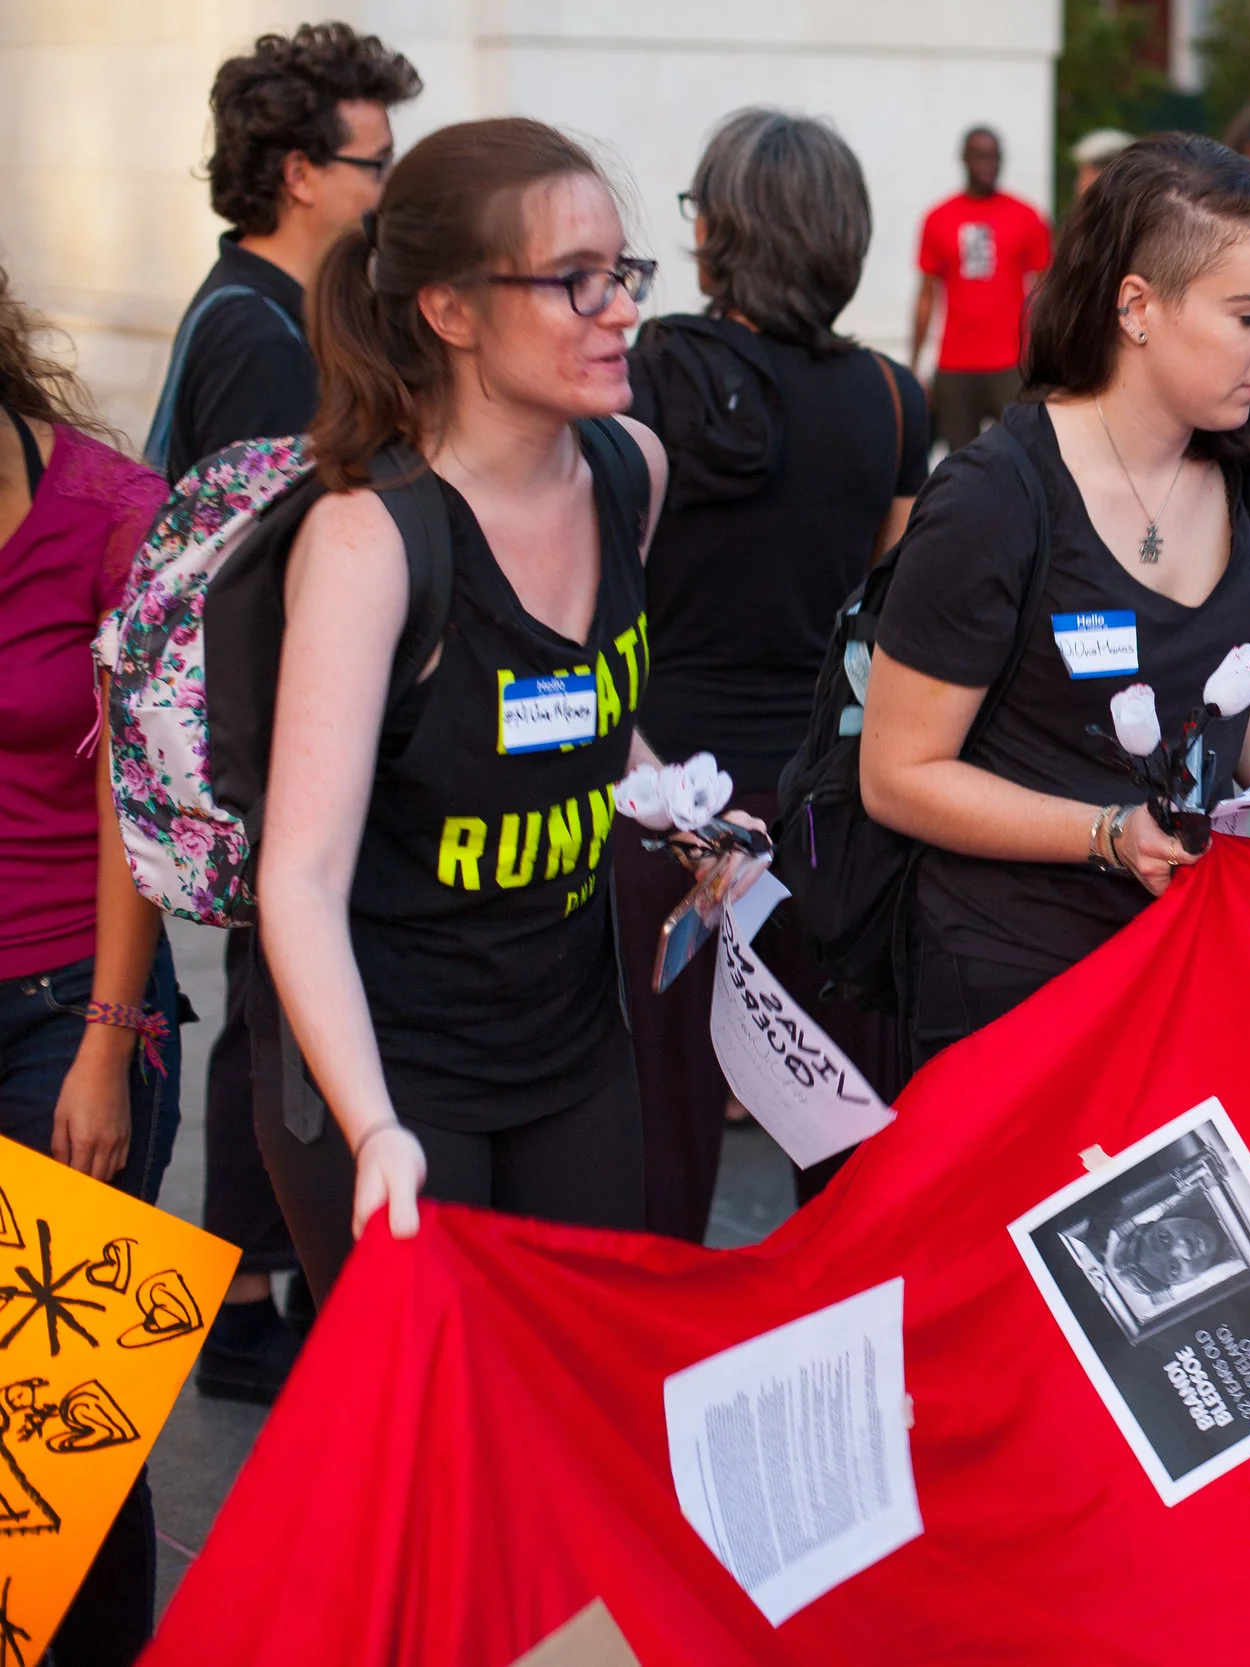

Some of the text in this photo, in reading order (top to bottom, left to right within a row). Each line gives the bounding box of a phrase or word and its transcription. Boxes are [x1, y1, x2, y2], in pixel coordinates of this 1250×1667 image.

[1077, 614, 1105, 626] Hello
[1195, 1330, 1221, 1359] OLD
[1163, 1360, 1216, 1431] BRANDI
[1174, 1345, 1234, 1427] BLEDSOE
[1212, 1359, 1245, 1402] YEARS
